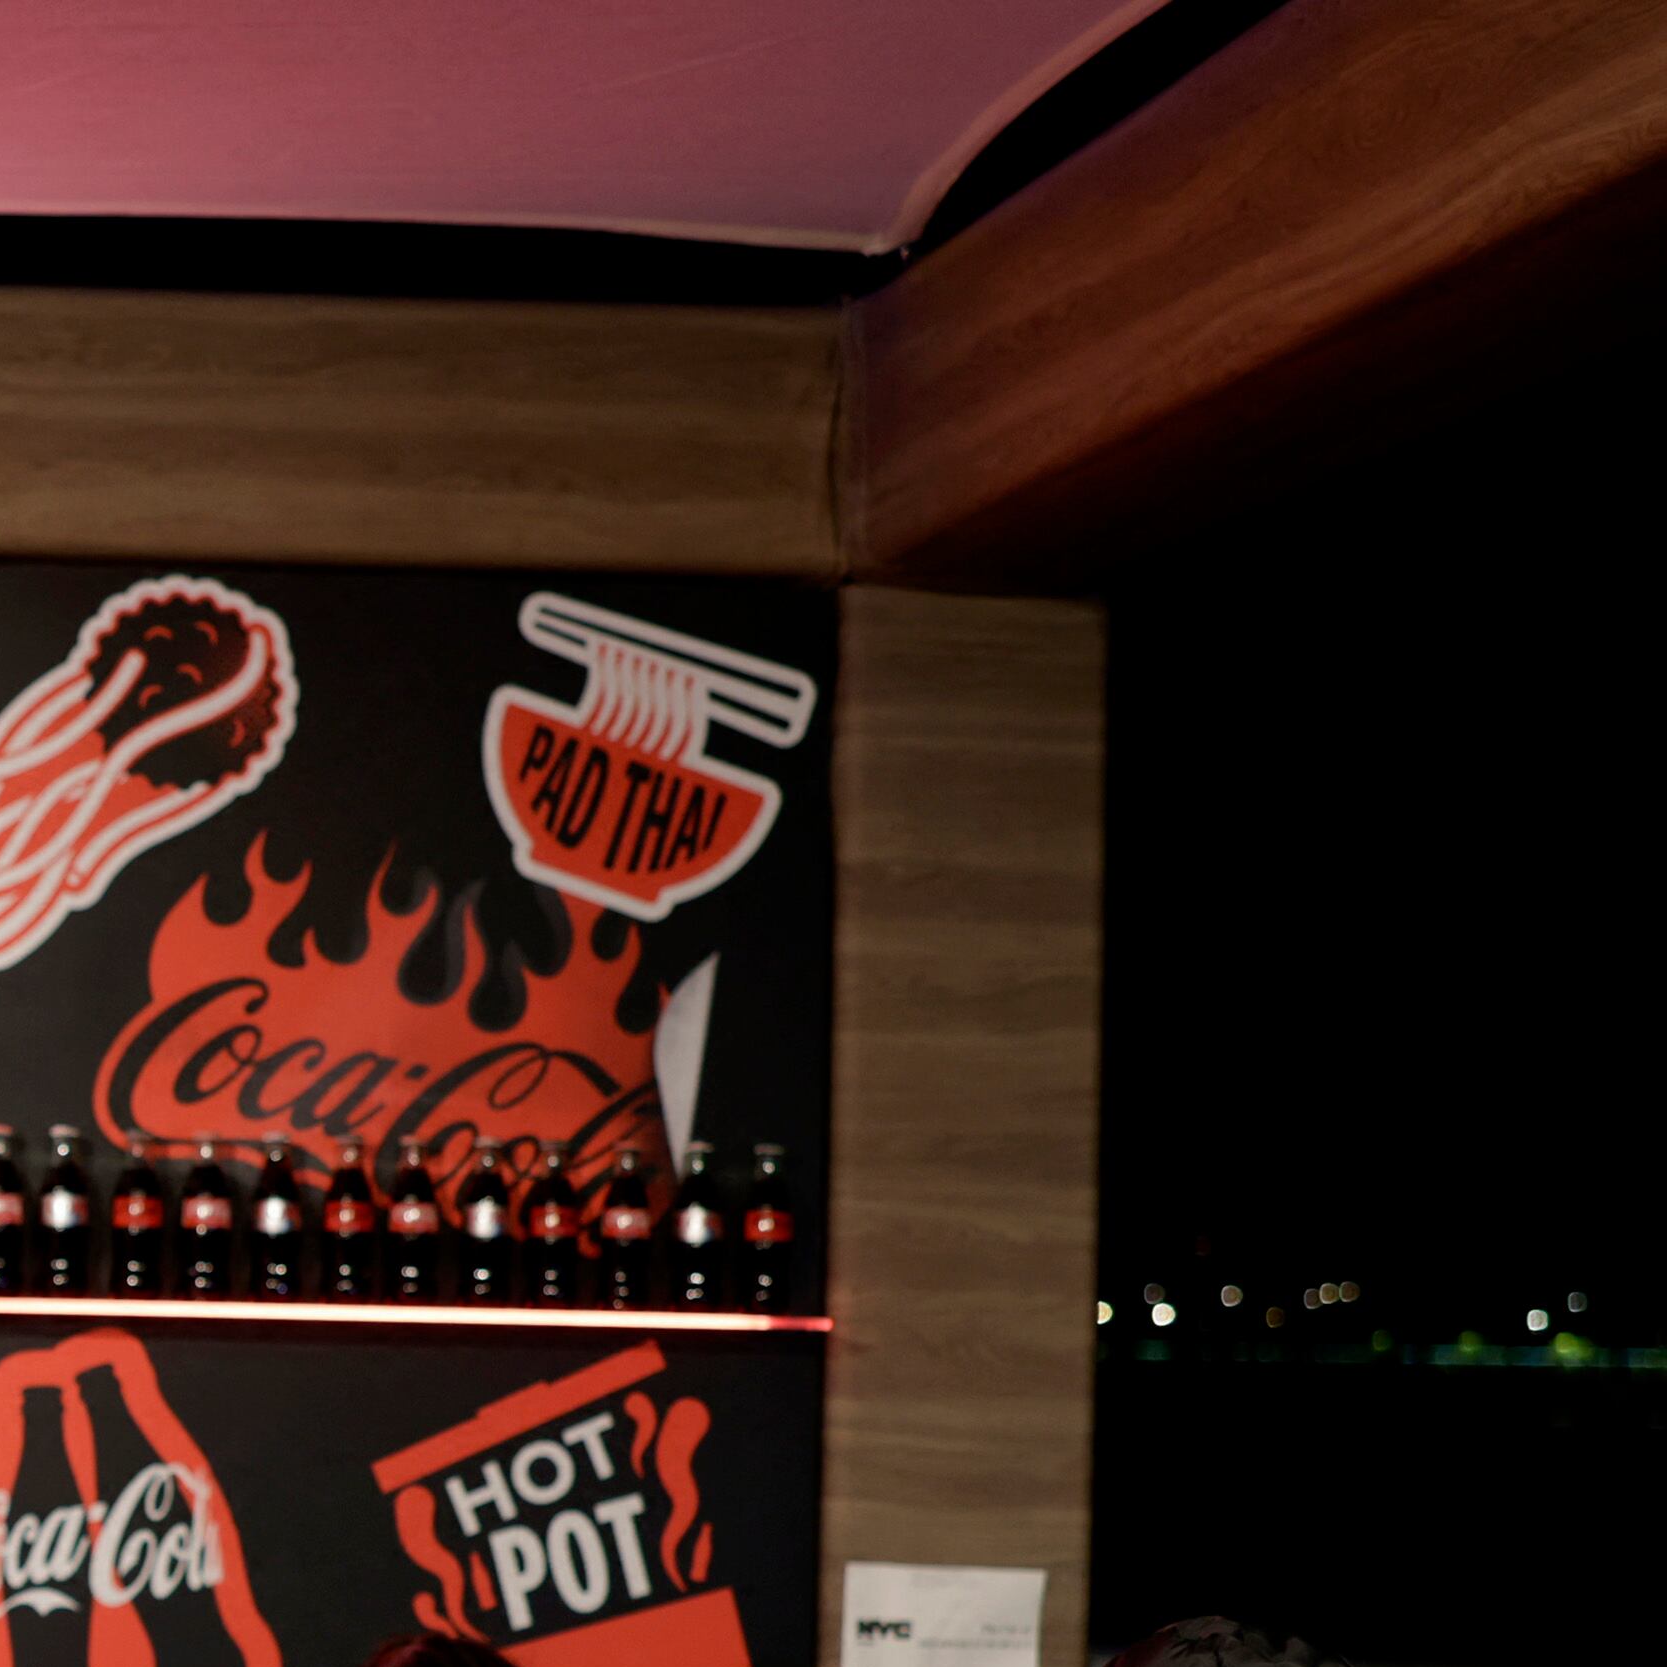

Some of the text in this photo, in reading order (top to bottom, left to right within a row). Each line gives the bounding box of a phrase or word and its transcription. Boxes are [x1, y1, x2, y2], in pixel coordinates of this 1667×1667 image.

[519, 723, 728, 873] PAD THAI
[445, 1411, 615, 1538] HOT
[487, 1491, 652, 1632] POT
[857, 1617, 912, 1639] NYC
